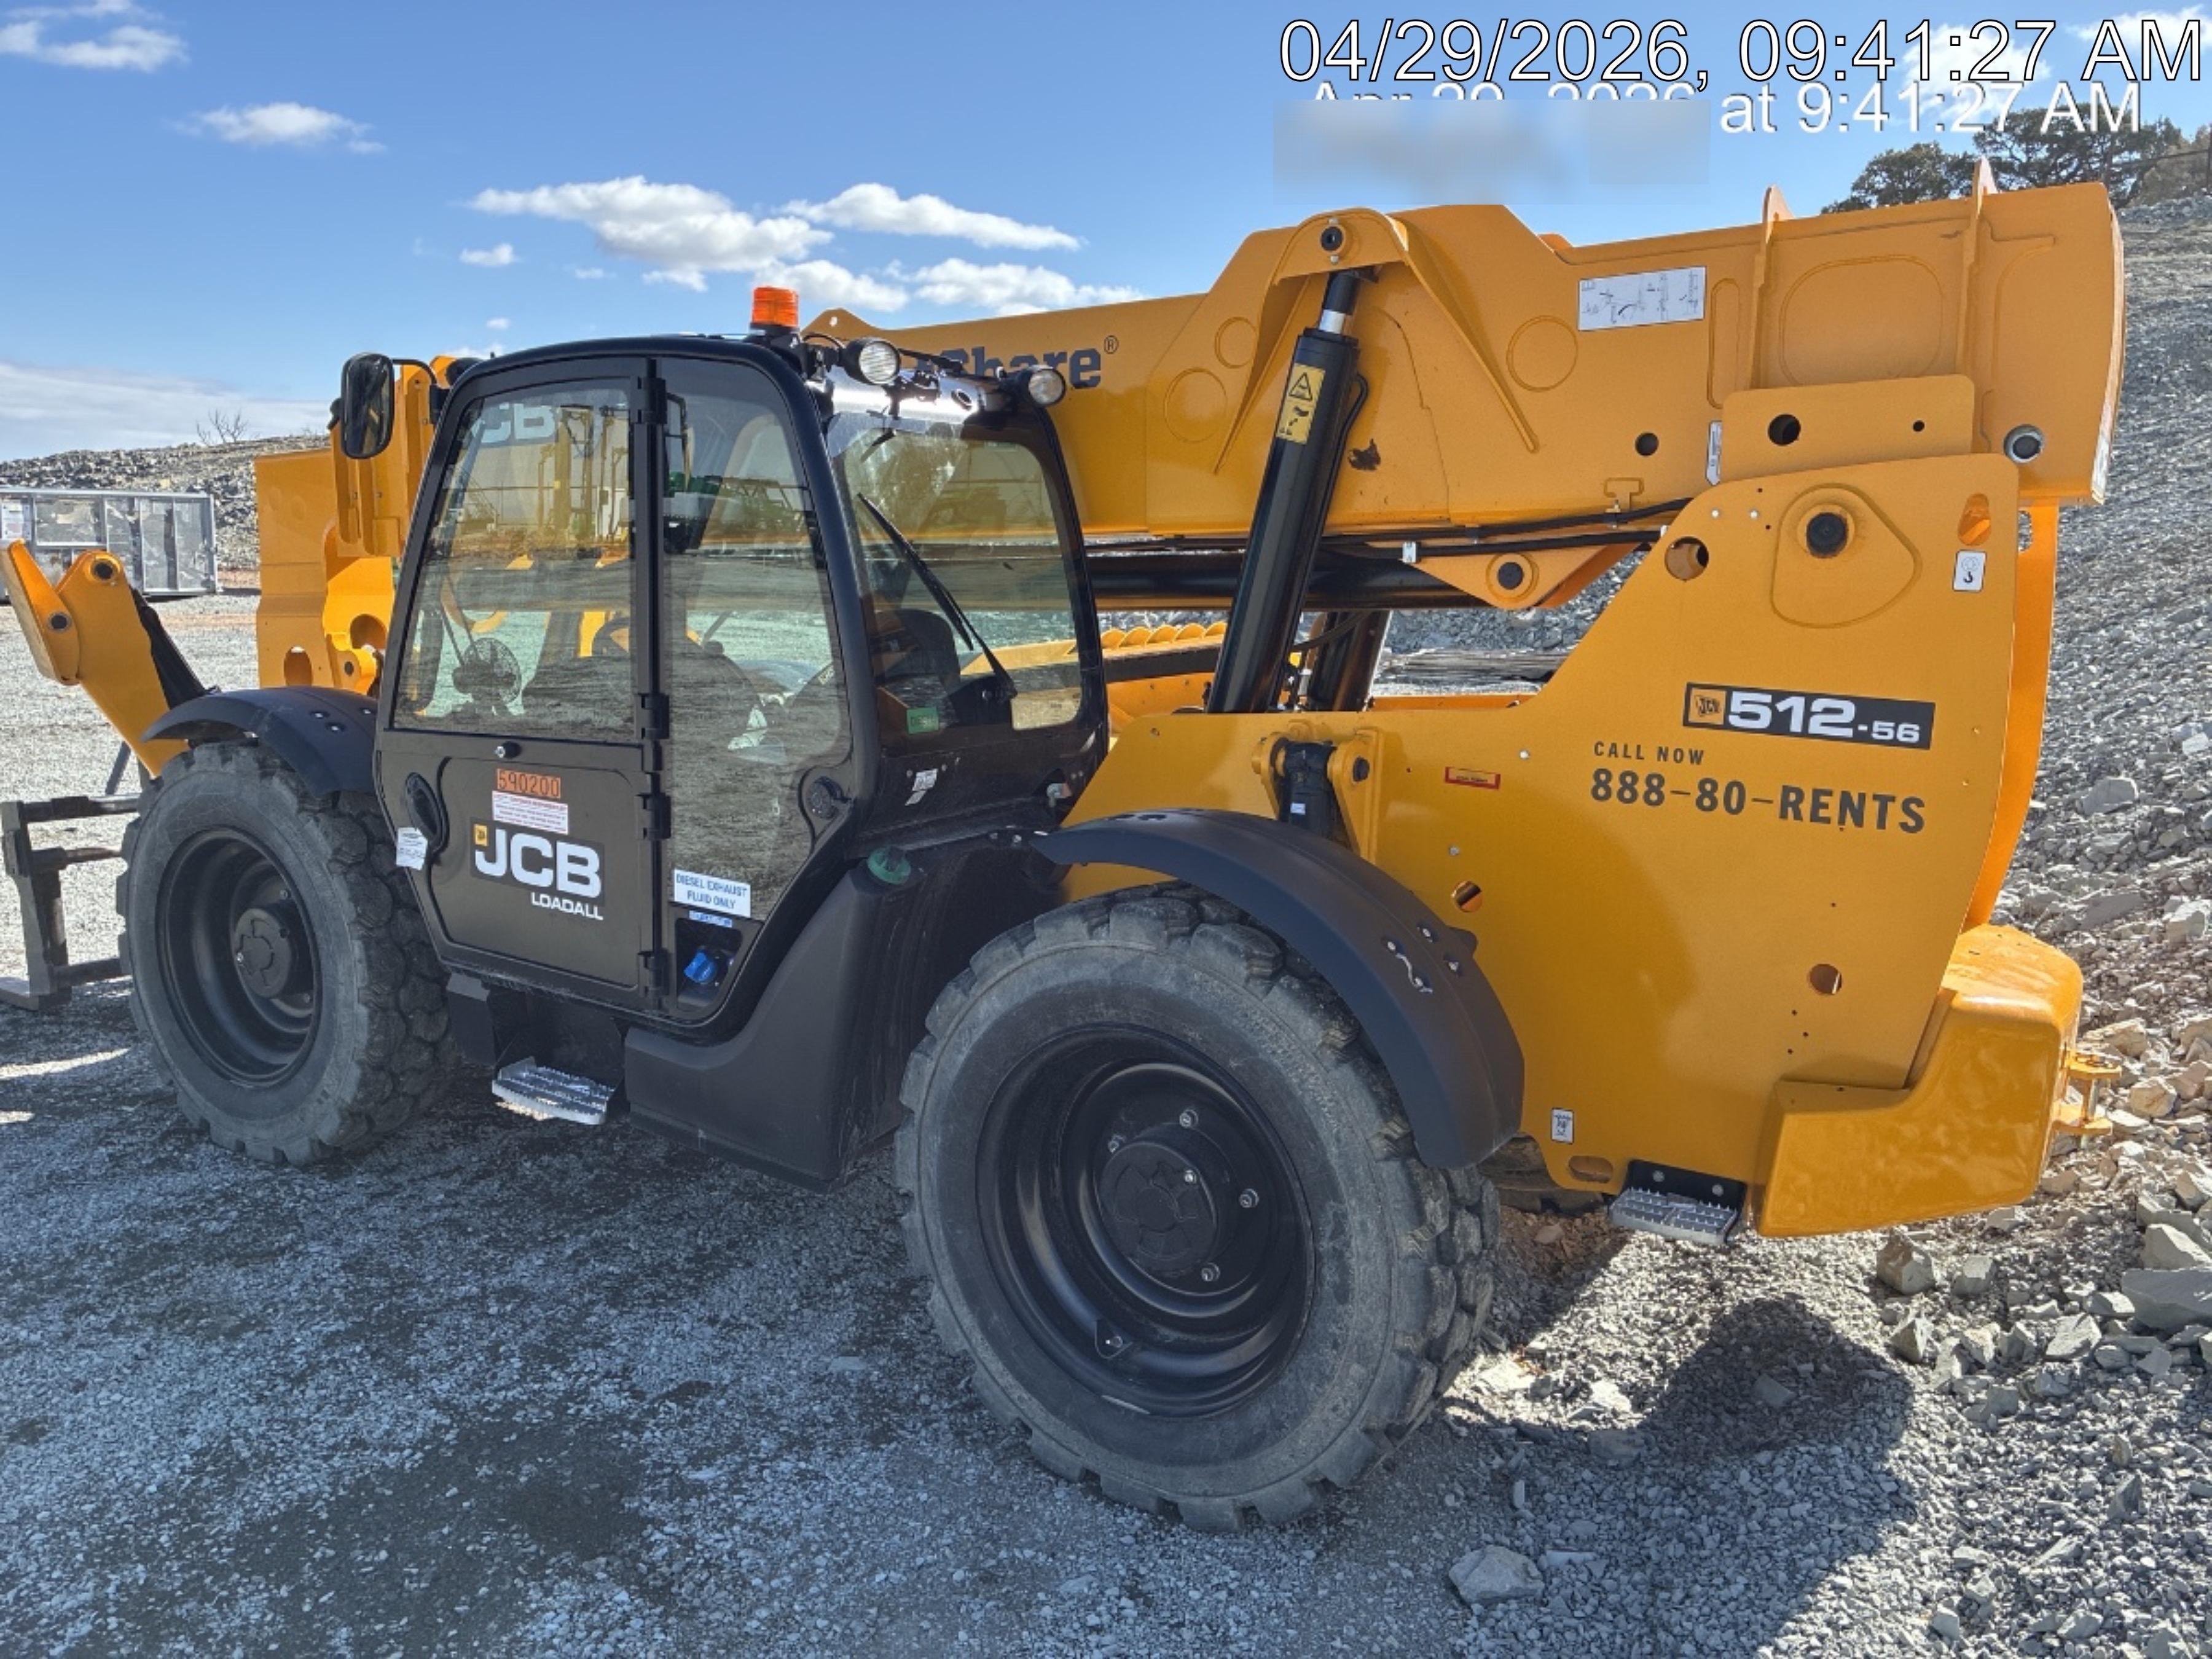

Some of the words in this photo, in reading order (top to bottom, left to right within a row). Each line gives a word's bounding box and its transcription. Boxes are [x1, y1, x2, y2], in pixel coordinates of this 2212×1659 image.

[471, 402, 555, 443] CB
[1594, 741, 1645, 760] CALL
[1657, 745, 1704, 765] NOW
[475, 829, 602, 898] JCB
[676, 873, 705, 889] DIESEL
[707, 879, 748, 897] EXHAUST
[531, 892, 604, 921] LOADALL
[713, 895, 736, 909] ONLY
